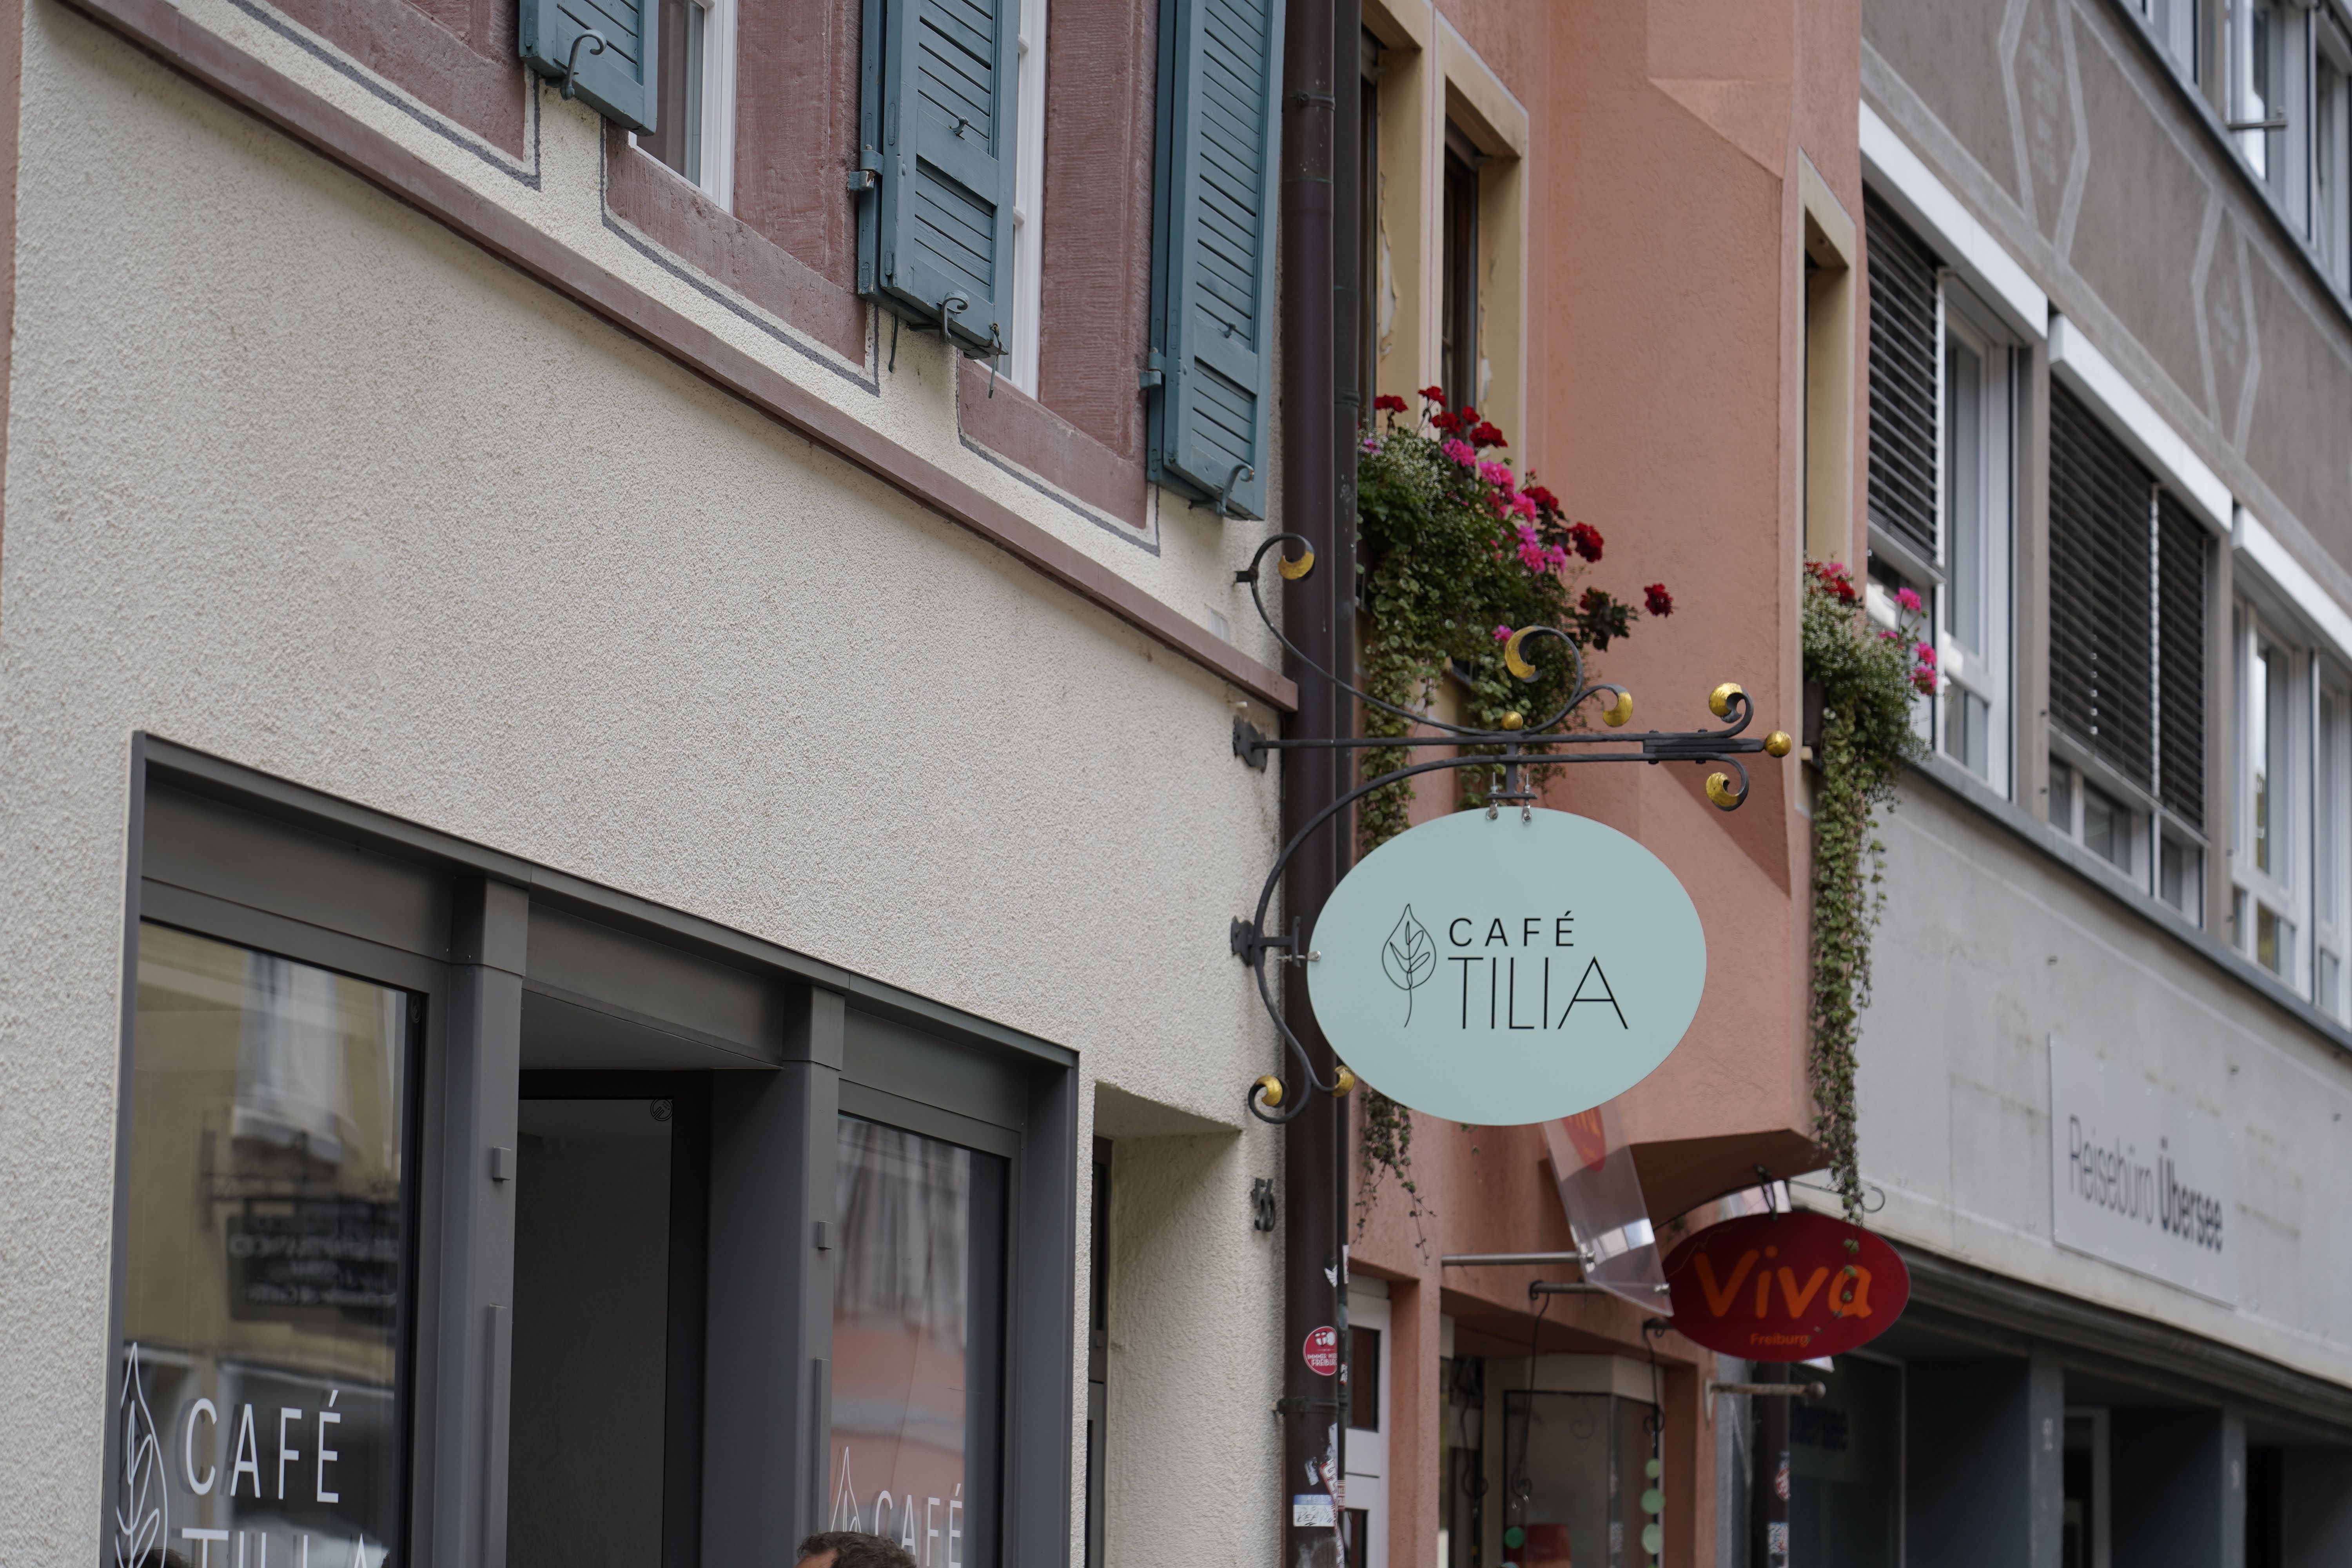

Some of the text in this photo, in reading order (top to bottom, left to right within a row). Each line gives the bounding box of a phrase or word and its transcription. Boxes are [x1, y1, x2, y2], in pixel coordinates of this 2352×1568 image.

[1448, 910, 1574, 947] CAFÉ
[1448, 956, 1628, 1029] TILIA
[2069, 1113, 2223, 1254] Reisebüro Übersee
[1693, 1245, 1873, 1319] Viva
[1750, 1333, 1809, 1347] Freiburg
[186, 1390, 340, 1503] CAFÉ
